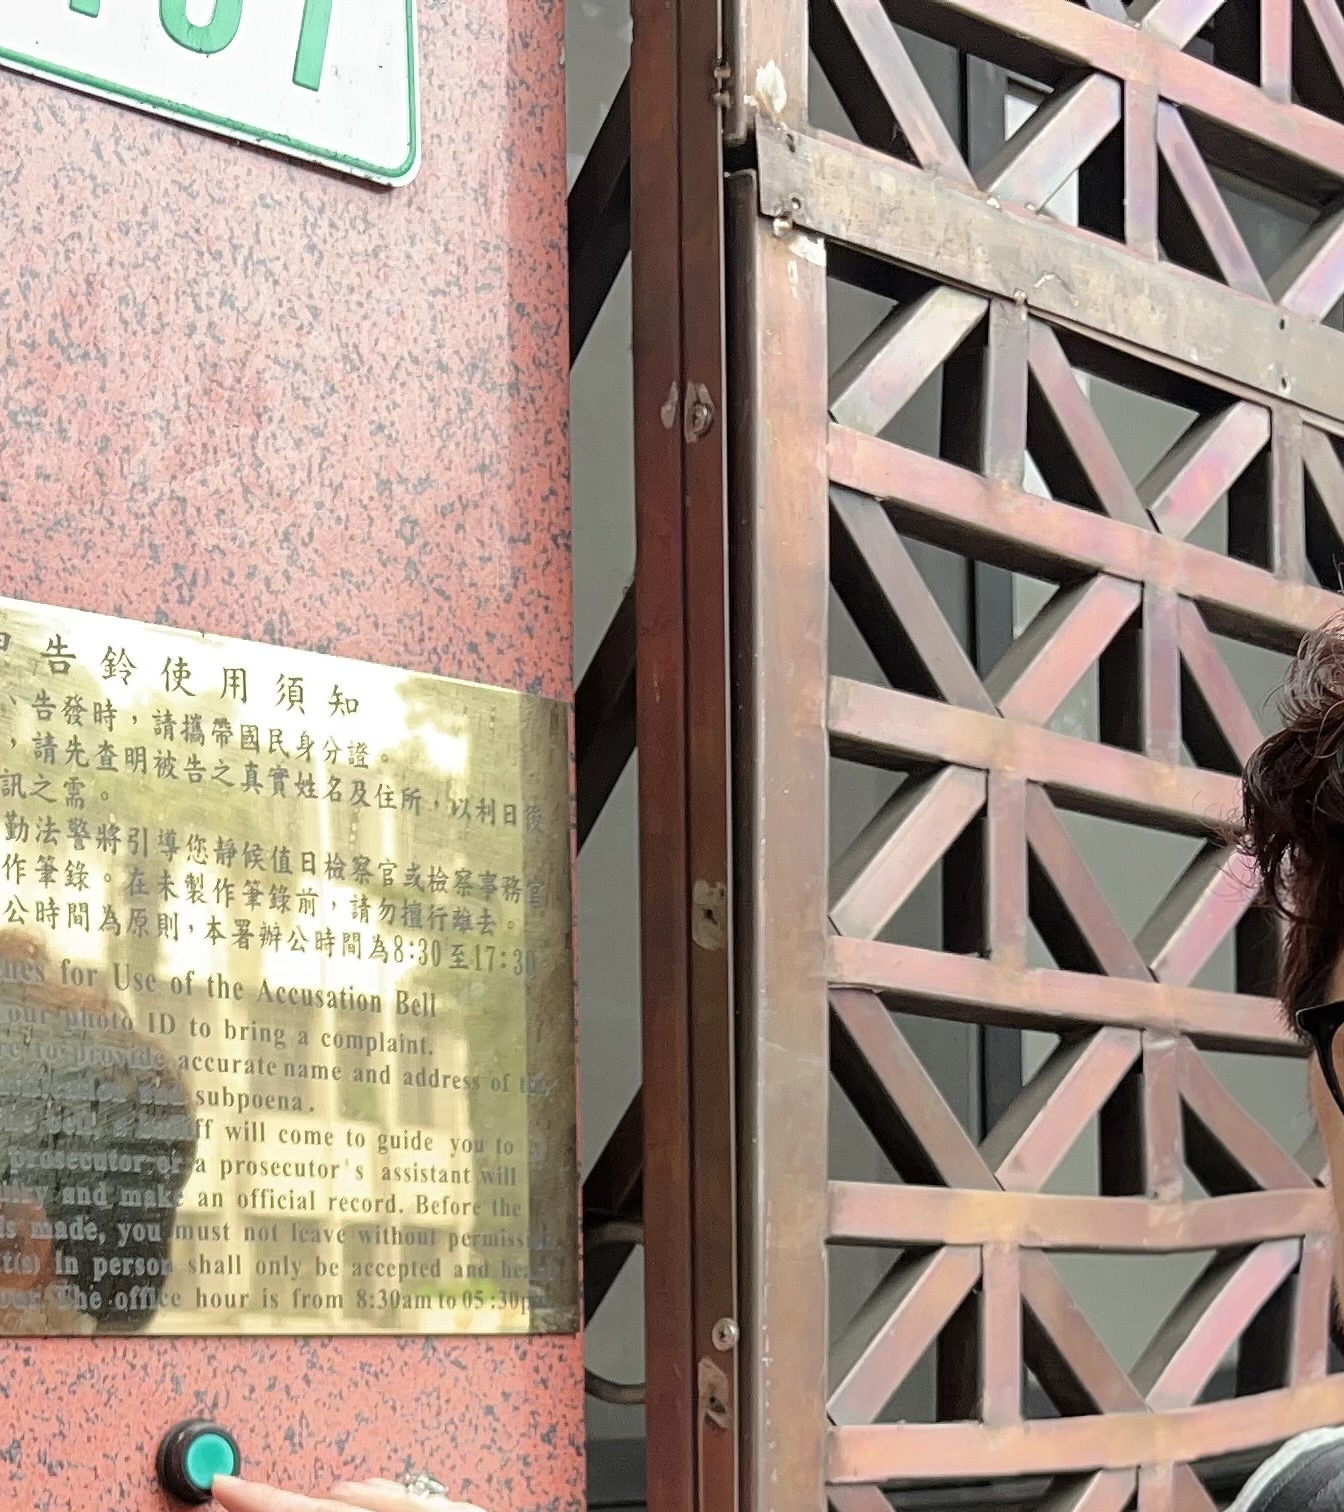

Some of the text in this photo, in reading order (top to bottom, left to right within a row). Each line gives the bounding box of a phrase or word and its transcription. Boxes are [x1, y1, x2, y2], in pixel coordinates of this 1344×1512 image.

[60, 959, 98, 987] for
[113, 961, 157, 992] Use
[170, 969, 196, 995] of
[207, 973, 244, 1000] the
[257, 980, 382, 1015] Accusation
[395, 989, 437, 1018] Bell
[65, 1006, 134, 1032] photo
[147, 1012, 177, 1036] ID
[190, 1016, 212, 1039] to
[223, 1018, 286, 1049] bring
[297, 1030, 309, 1046] a
[321, 1031, 434, 1057] complaint.
[73, 1045, 166, 1071] provide
[177, 1053, 277, 1077] accurate
[283, 1060, 342, 1081] name
[352, 1064, 392, 1086] and
[403, 1068, 481, 1092] address
[489, 1071, 512, 1093] of
[196, 1085, 316, 1113] subpoena.
[225, 1121, 266, 1143] will
[278, 1125, 334, 1146] come
[347, 1129, 366, 1147] to
[378, 1130, 434, 1155] guide
[451, 1138, 484, 1159] you
[496, 1136, 514, 1156] to
[9, 1149, 150, 1175] prosecutor
[195, 1158, 206, 1174] a
[381, 1167, 472, 1186] assistant
[480, 1165, 516, 1186] will
[62, 1181, 112, 1209] and
[118, 1183, 184, 1209] make
[197, 1192, 223, 1209] an
[237, 1186, 316, 1211] official
[328, 1193, 405, 1215] record.
[416, 1194, 482, 1217] Before
[491, 1196, 522, 1218] the
[31, 1214, 107, 1245] made,
[116, 1219, 163, 1248] you
[174, 1222, 231, 1241] must
[243, 1223, 279, 1242] not
[291, 1223, 347, 1243] leave
[357, 1225, 437, 1247] without
[56, 1247, 80, 1276] in
[92, 1253, 174, 1281] person
[188, 1253, 243, 1276] shall
[255, 1254, 303, 1281] only
[315, 1255, 341, 1278] be
[351, 1258, 443, 1283] accepted
[453, 1258, 490, 1279] and
[114, 1284, 182, 1312] office
[196, 1286, 249, 1309] hour
[261, 1287, 280, 1310] is
[292, 1287, 344, 1310] from
[355, 1289, 436, 1311] 8:30am
[437, 1290, 457, 1311] to
